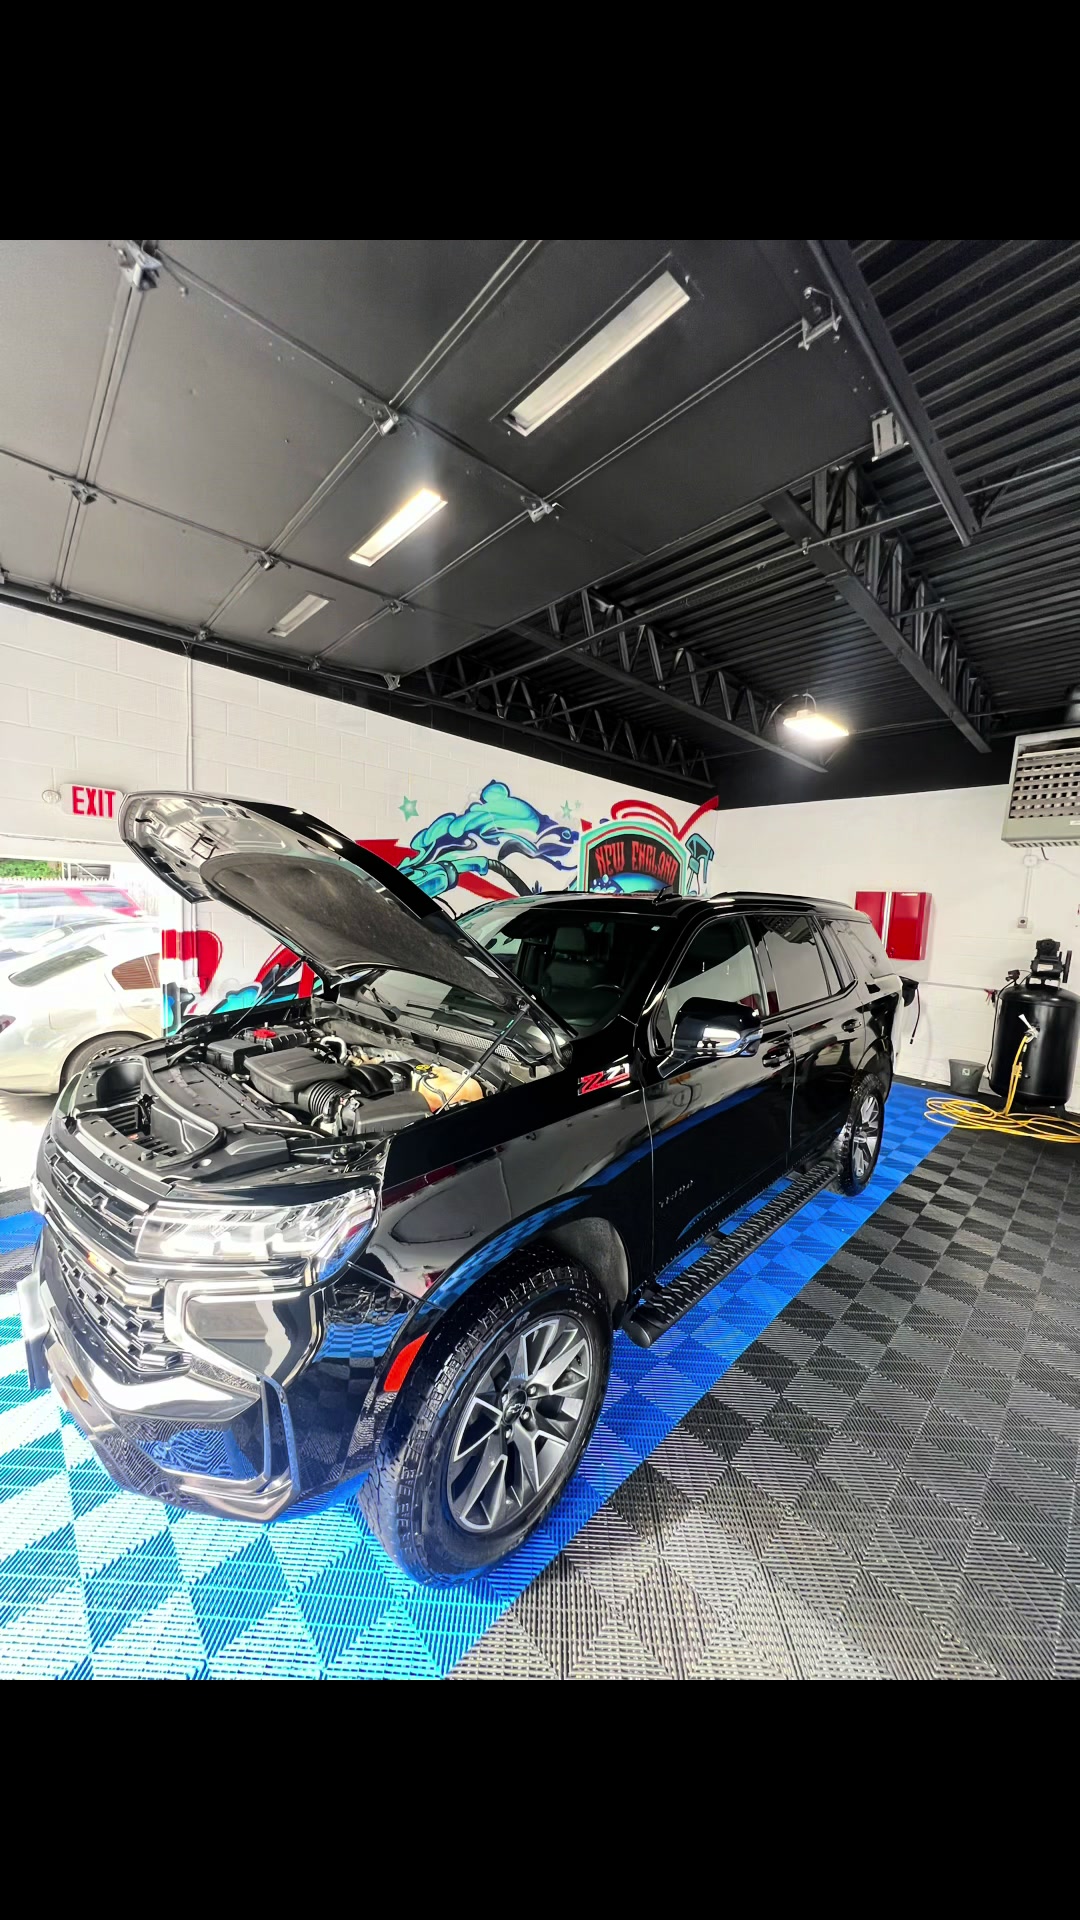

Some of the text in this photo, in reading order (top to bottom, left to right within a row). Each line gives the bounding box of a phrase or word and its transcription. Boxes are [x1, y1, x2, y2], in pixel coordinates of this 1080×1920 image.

[72, 786, 116, 818] EXIT
[595, 841, 679, 885] NEW ENGLAND
[577, 1063, 630, 1095] Z71
